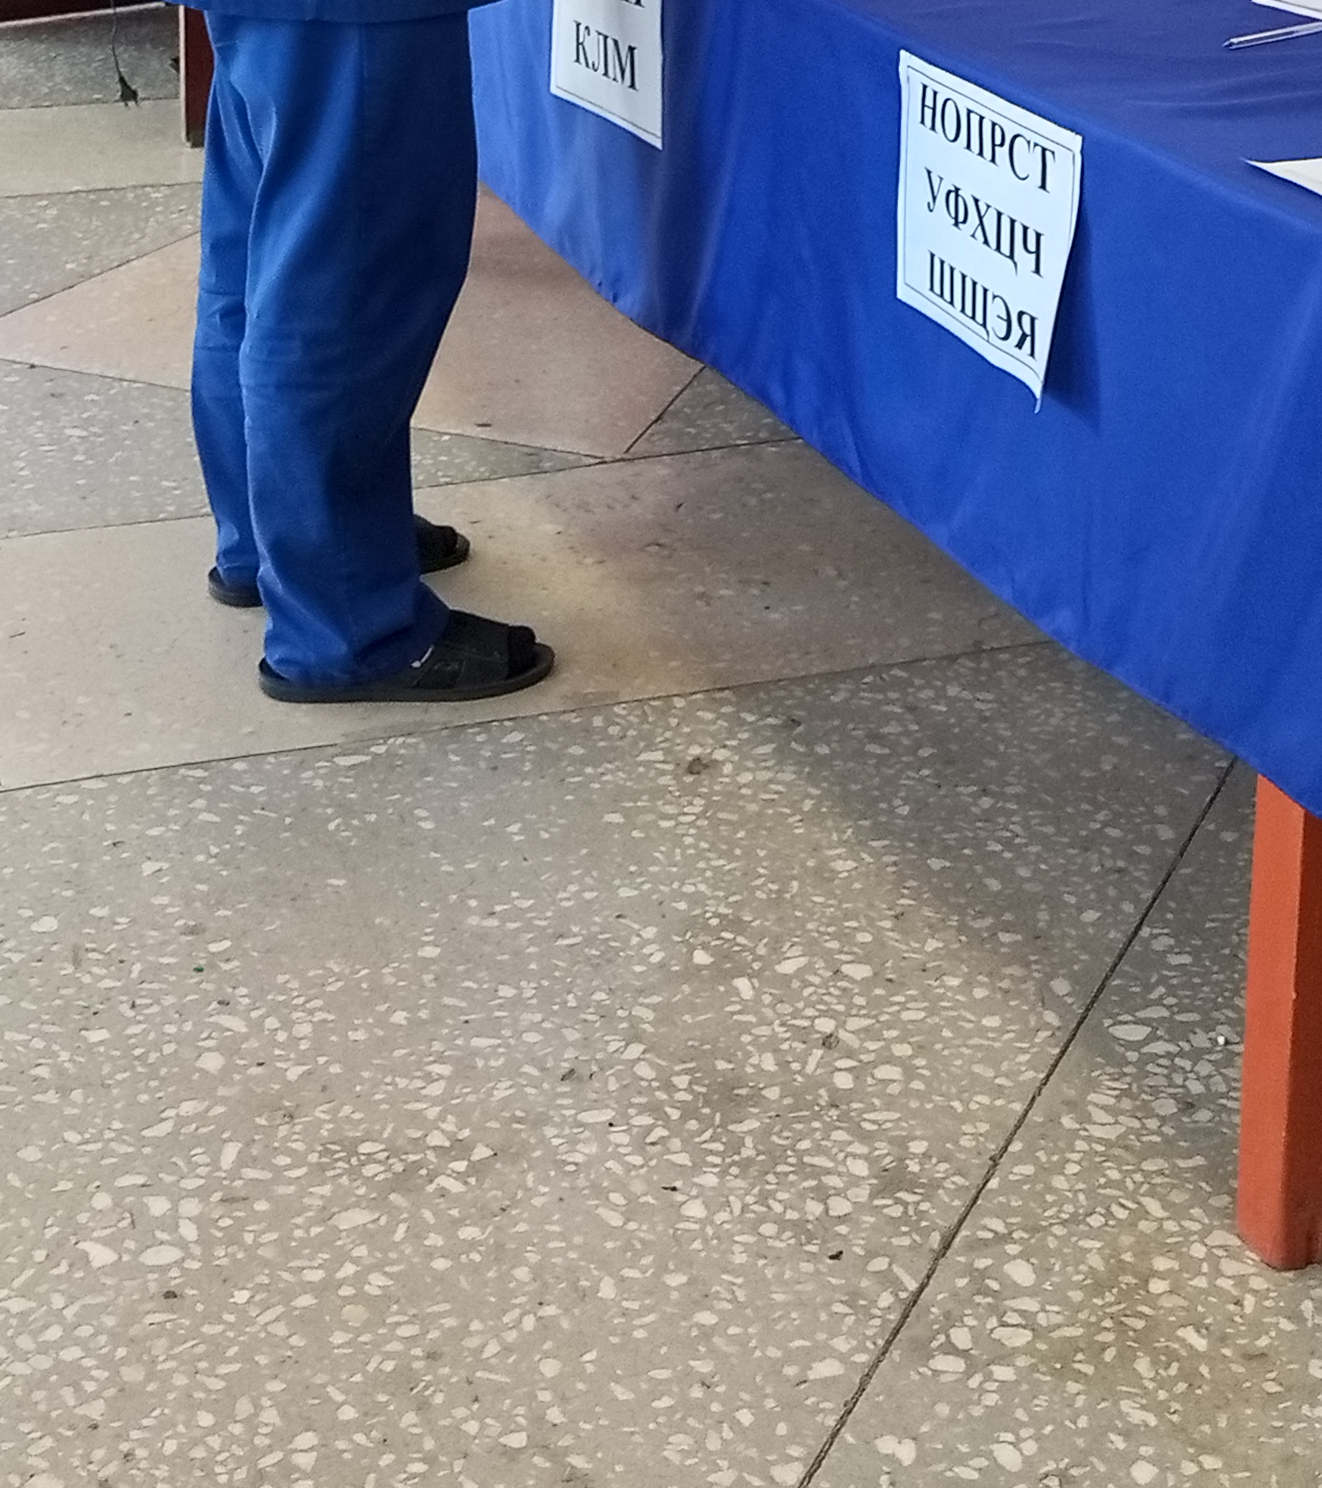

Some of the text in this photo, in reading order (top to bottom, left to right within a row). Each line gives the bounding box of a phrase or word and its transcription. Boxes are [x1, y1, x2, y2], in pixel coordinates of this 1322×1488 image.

[573, 20, 639, 91] КЛМ
[918, 82, 1055, 194] НОПРСТ
[924, 166, 1044, 278] УФХЦЧ
[927, 250, 1039, 360] ШЩЭЯ
